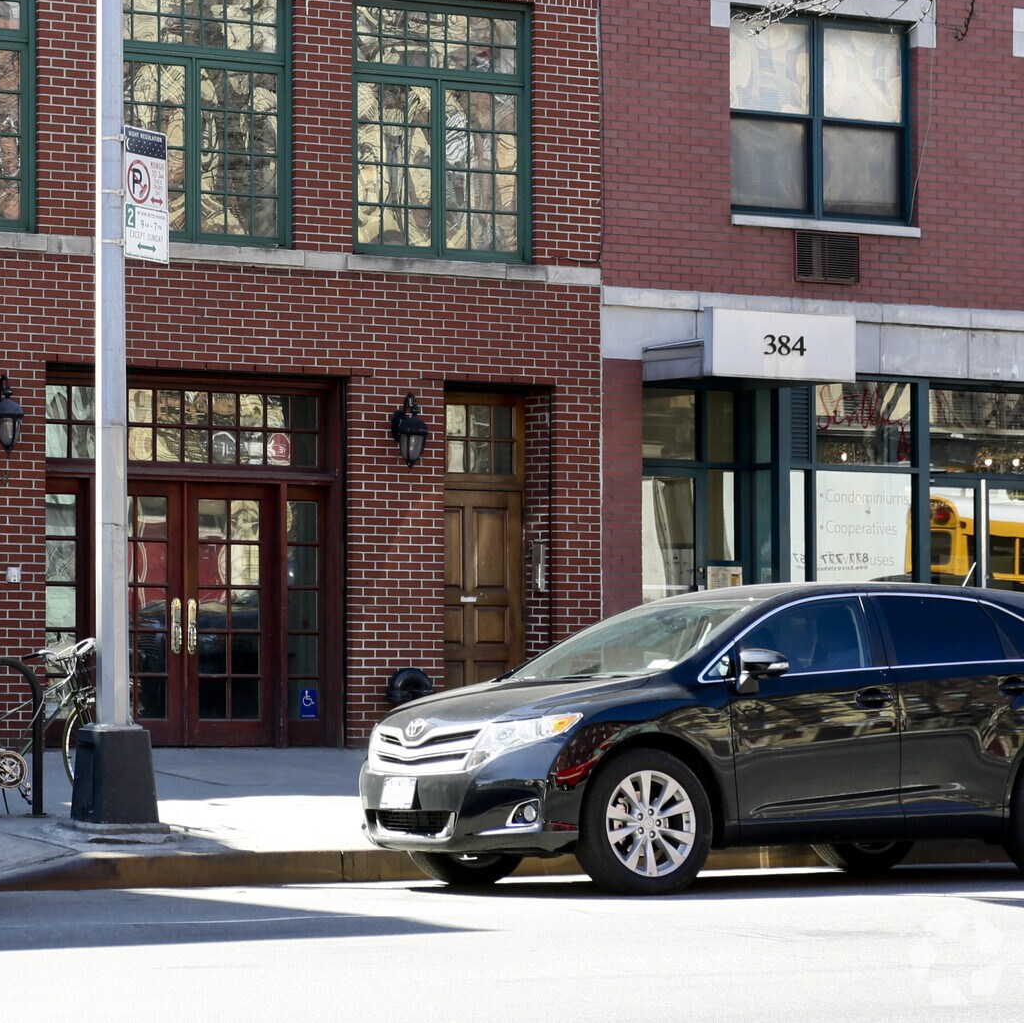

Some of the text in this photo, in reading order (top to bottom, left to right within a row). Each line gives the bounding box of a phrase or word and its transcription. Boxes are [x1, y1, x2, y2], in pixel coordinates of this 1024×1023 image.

[127, 207, 134, 226] 2
[129, 229, 164, 243] EXCEPT SUNDAY
[762, 333, 807, 357] 384
[825, 488, 910, 506] Condominiums
[825, 519, 898, 537] Cooperatives
